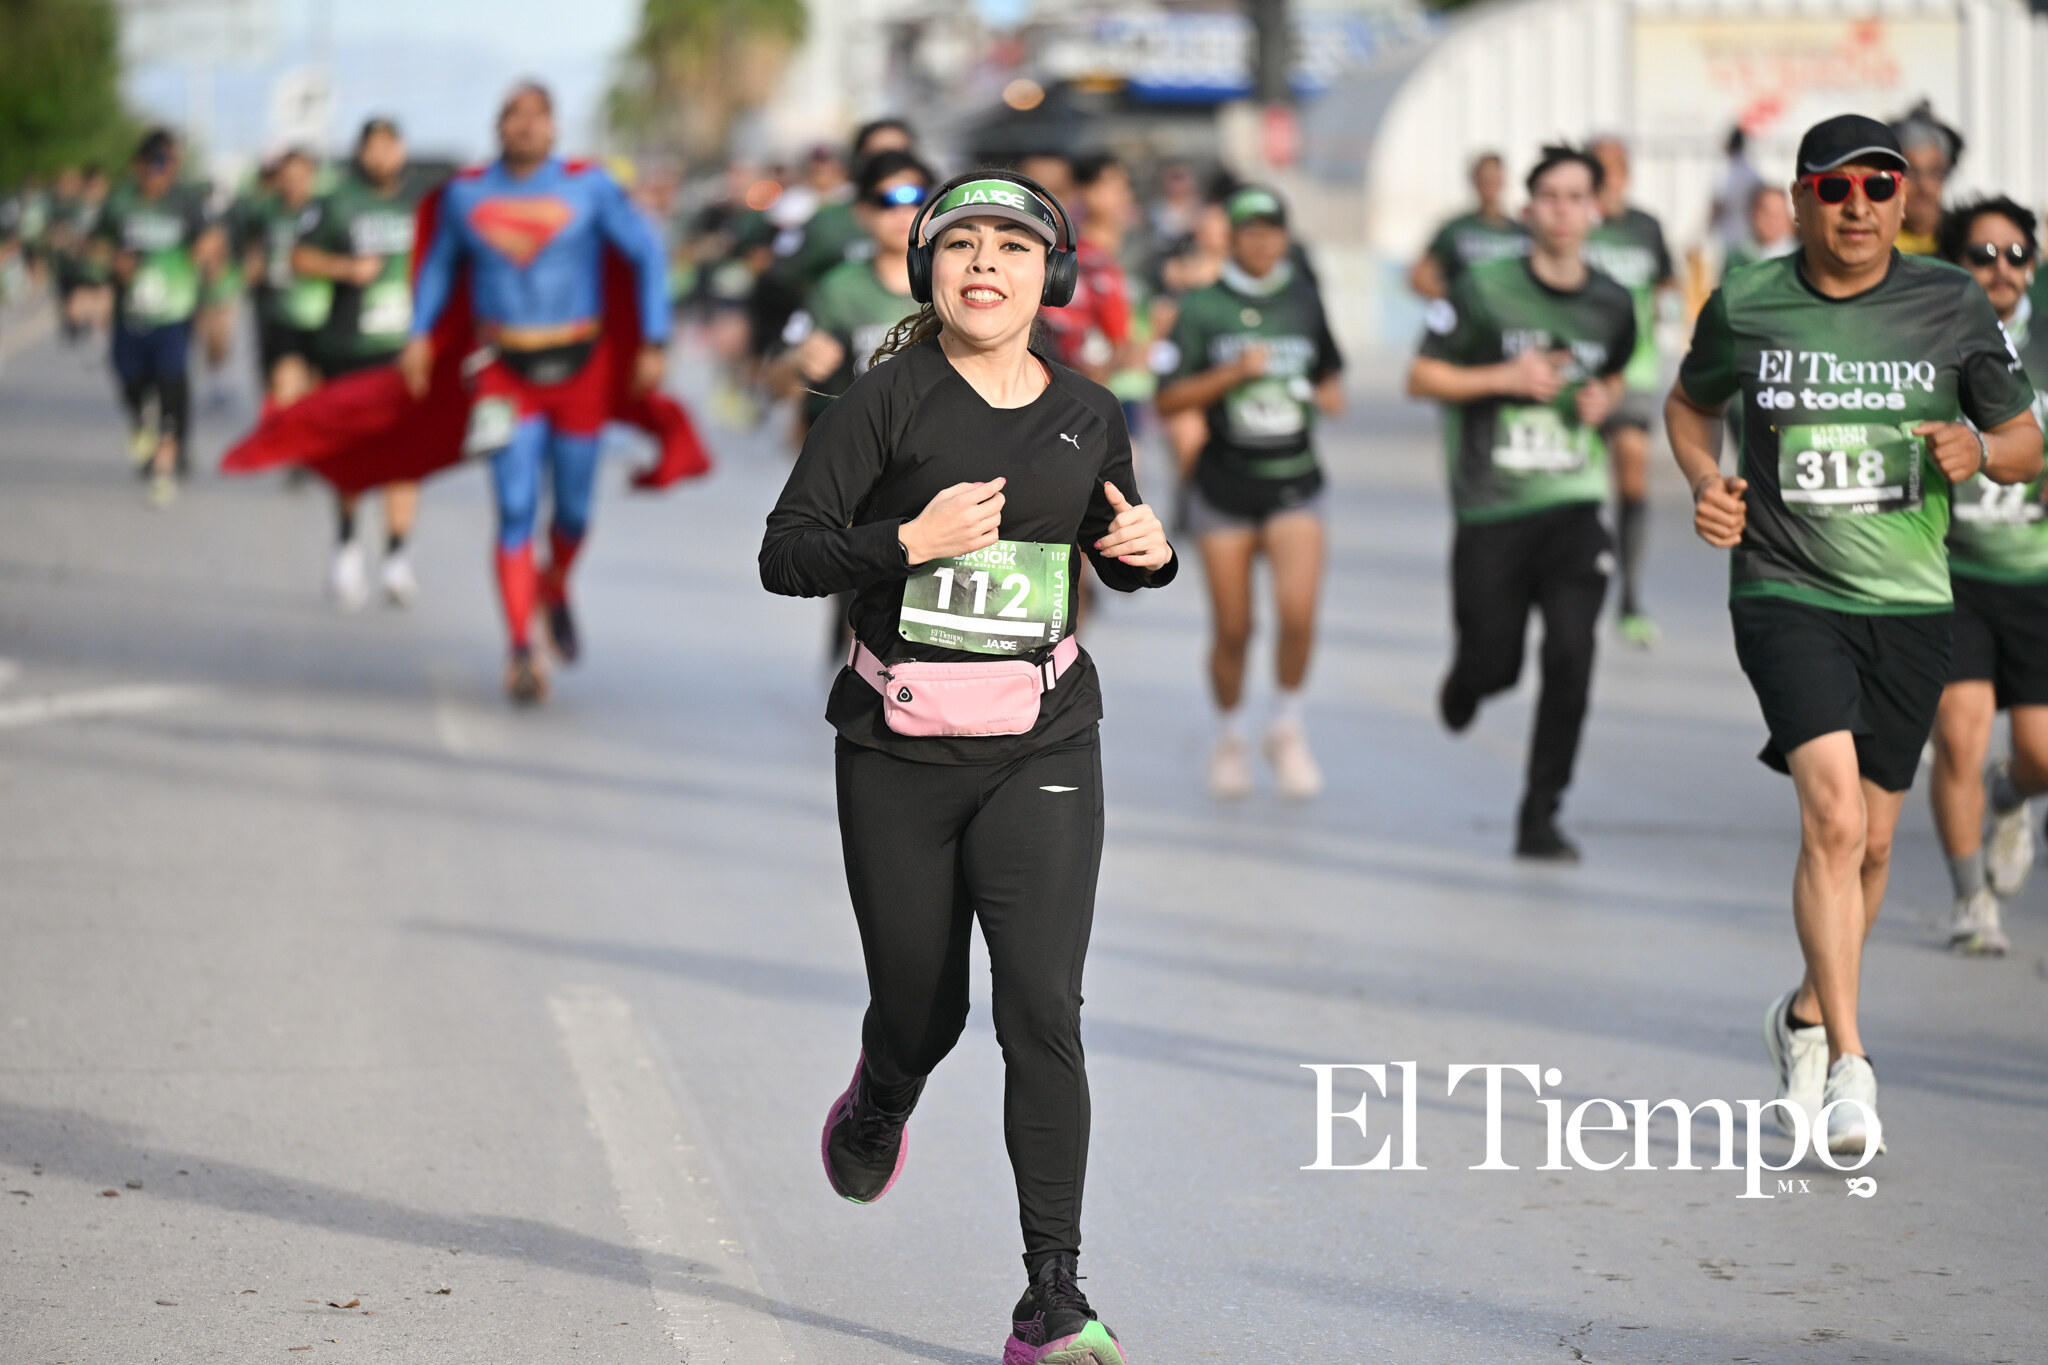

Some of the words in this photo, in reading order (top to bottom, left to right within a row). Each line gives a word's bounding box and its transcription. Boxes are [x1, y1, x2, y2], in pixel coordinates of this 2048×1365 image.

[1758, 350, 1792, 383] El
[1799, 351, 1936, 392] Tiempo
[1756, 387, 1796, 409] de
[1800, 388, 1906, 410] todos
[1796, 450, 1885, 489] 318
[1051, 552, 1067, 561] 112
[933, 567, 1030, 618] 112
[1049, 569, 1064, 643] MEDALLA
